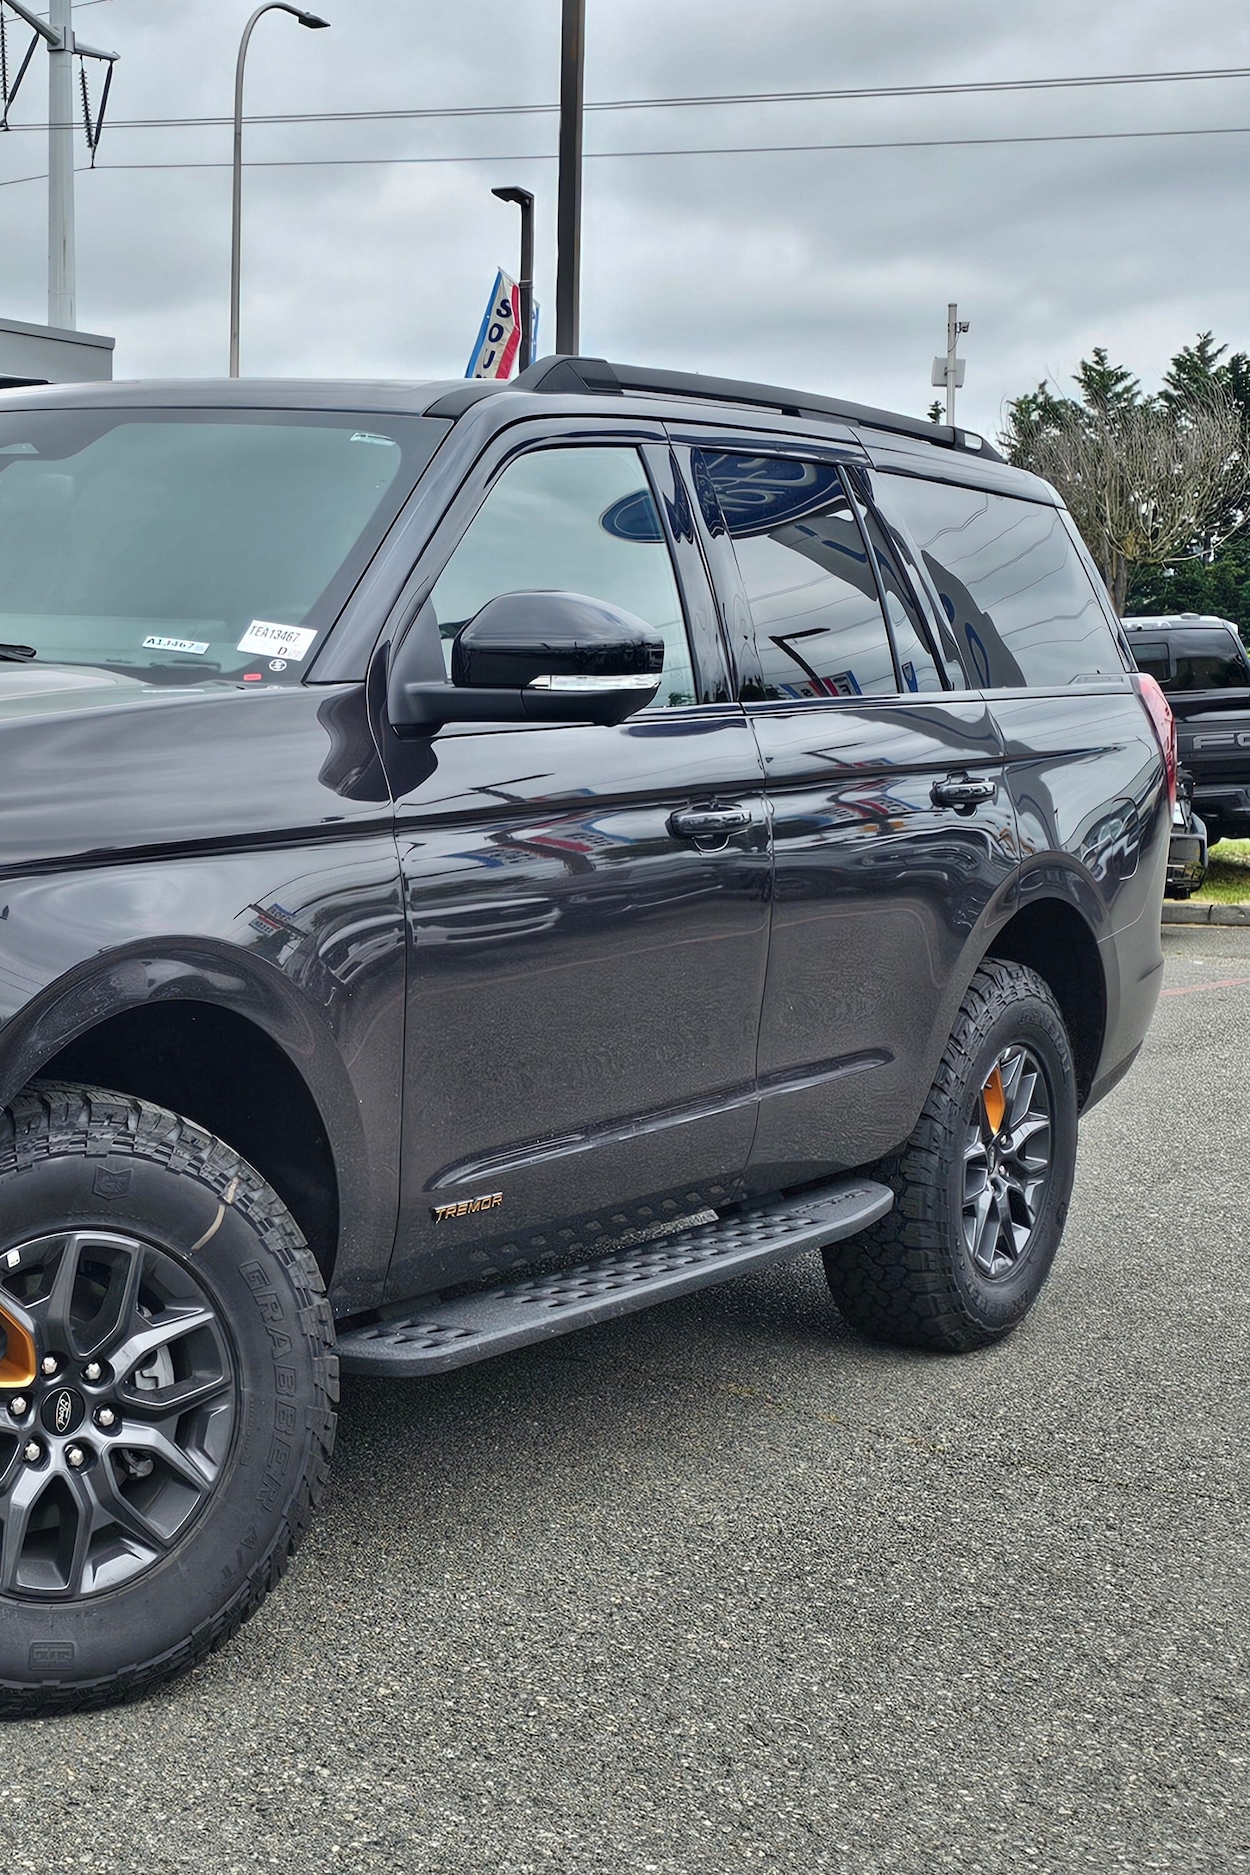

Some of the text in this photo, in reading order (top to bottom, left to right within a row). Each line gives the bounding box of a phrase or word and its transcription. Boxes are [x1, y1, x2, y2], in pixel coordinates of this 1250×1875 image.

[475, 298, 512, 378] SOU
[249, 625, 301, 643] TEA13467
[432, 1191, 504, 1225] TREMOR
[238, 1259, 297, 1513] GRABBER
